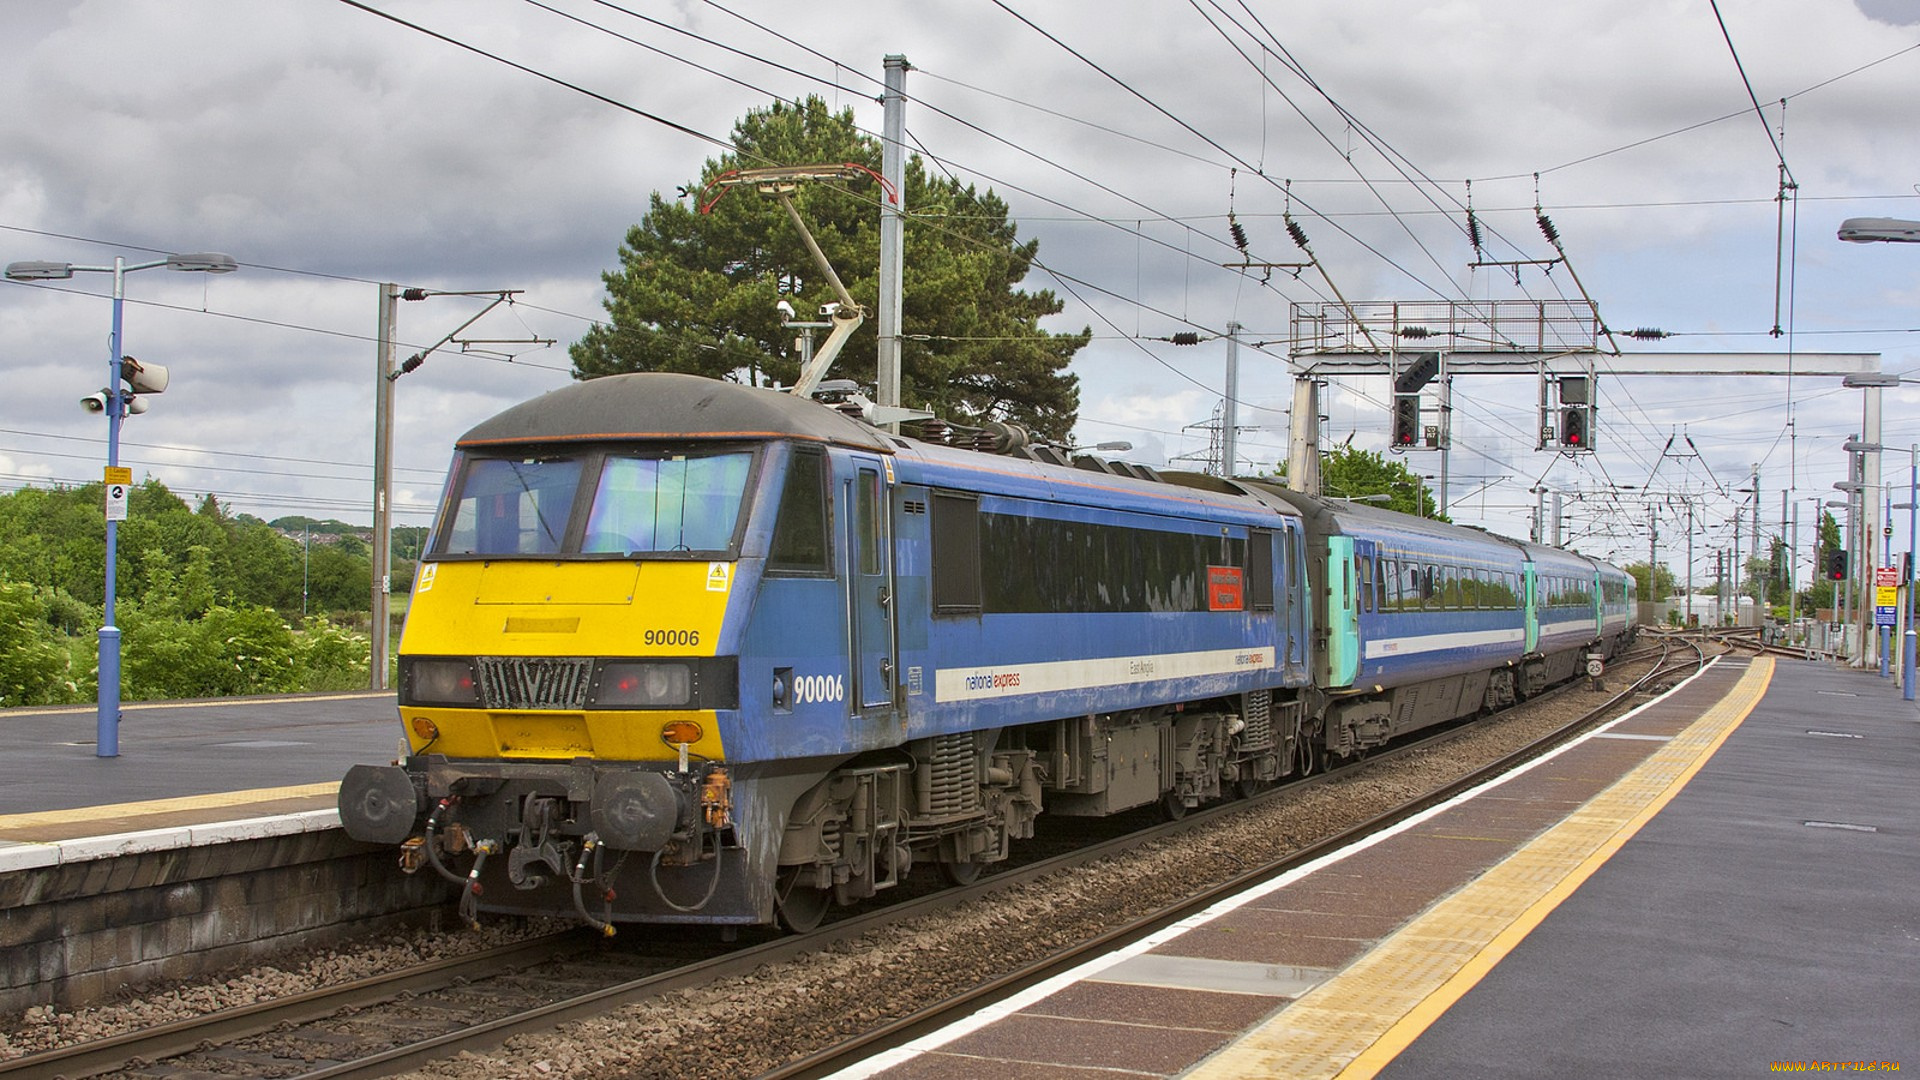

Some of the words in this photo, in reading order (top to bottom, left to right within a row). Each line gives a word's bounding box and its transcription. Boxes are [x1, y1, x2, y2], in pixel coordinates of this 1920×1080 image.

[644, 629, 700, 647] 90006
[1590, 663, 1601, 673] 25
[793, 674, 844, 704] 90006
[965, 669, 993, 691] national
[994, 673, 1020, 692] express
